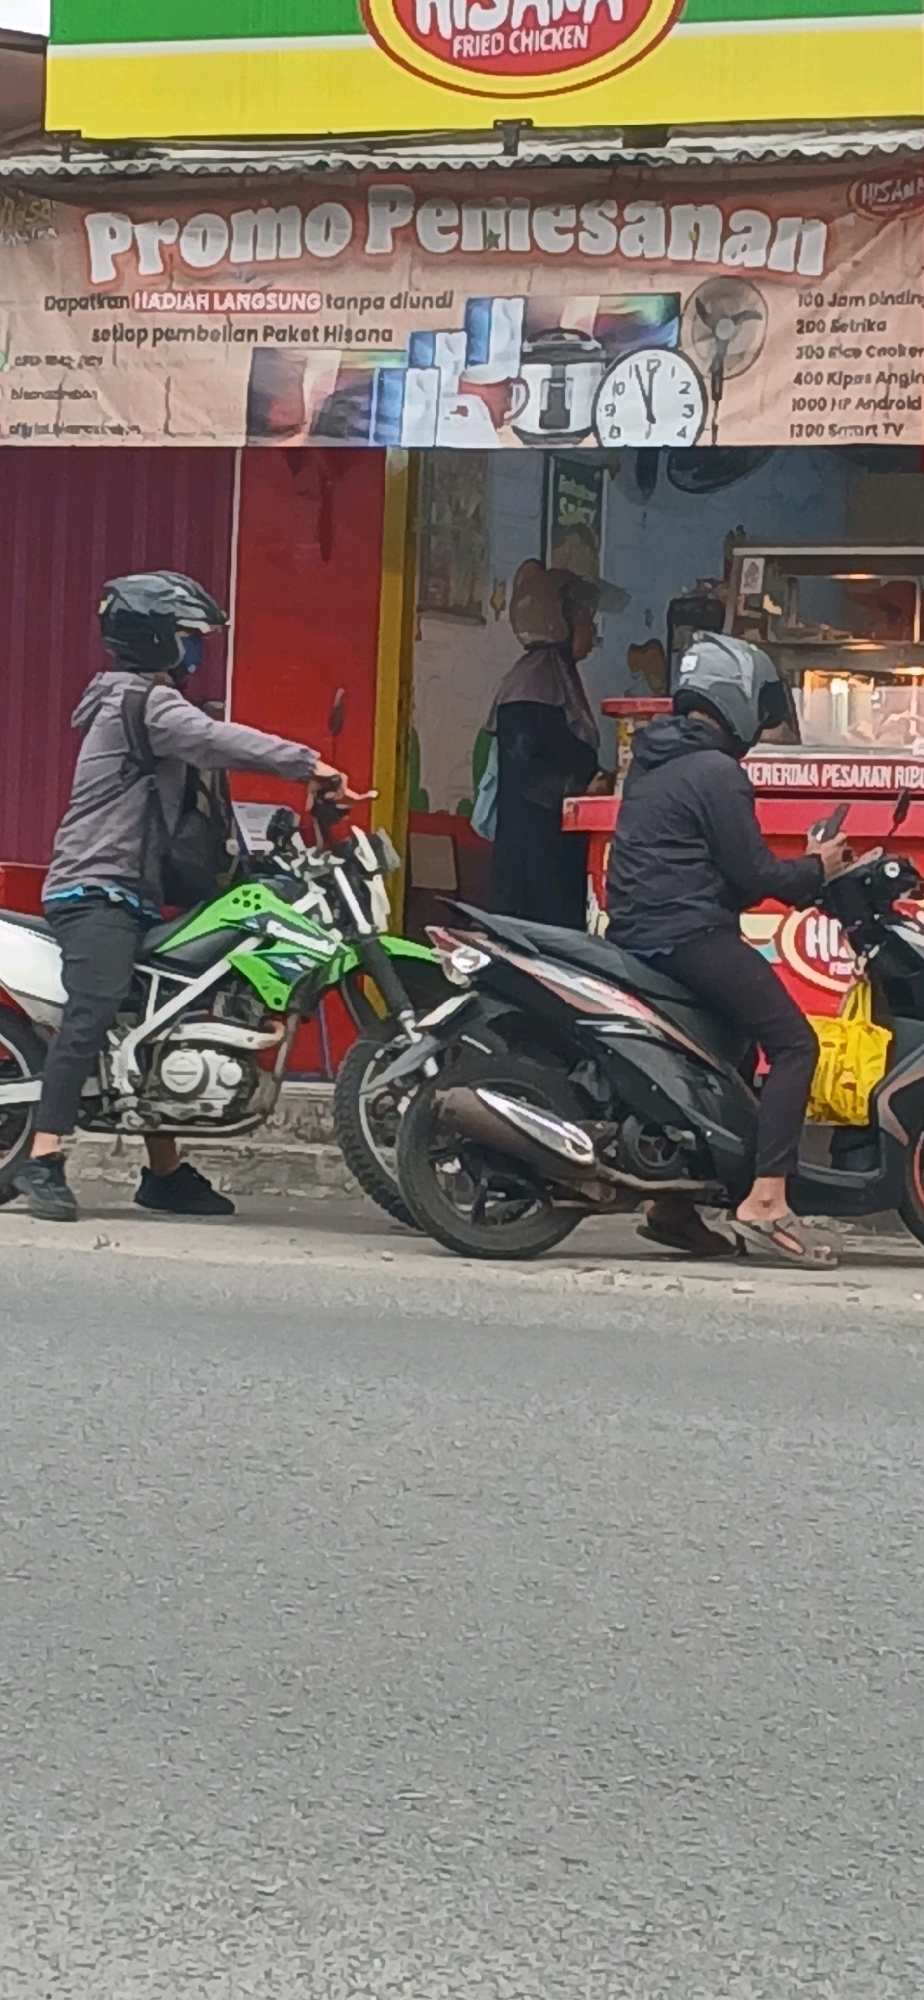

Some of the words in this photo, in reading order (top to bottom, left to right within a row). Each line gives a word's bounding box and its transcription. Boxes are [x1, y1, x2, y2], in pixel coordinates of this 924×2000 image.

[453, 32, 504, 58] FRIED
[509, 25, 588, 55] CHICKEN
[85, 202, 352, 283] Promo
[365, 184, 827, 276] Pemesanan
[44, 293, 130, 317] Dapatkan
[134, 291, 209, 310] HADIAH
[213, 292, 322, 311] LANGSUNG
[326, 294, 385, 315] tanpa
[390, 291, 454, 310] diundi
[798, 292, 824, 308] 100
[828, 292, 866, 307] Jam
[796, 319, 826, 334] 200
[830, 317, 887, 333] Setrika
[92, 323, 149, 348] setiap
[152, 324, 258, 347] pembelian
[263, 325, 319, 343] Paket
[324, 324, 393, 343] Hisana
[793, 371, 824, 385] 400
[612, 380, 625, 397] 10
[679, 381, 692, 394] 2
[604, 402, 616, 417] 9
[682, 404, 695, 419] 3
[792, 397, 827, 412] 1000
[855, 395, 922, 410] Android
[677, 426, 687, 439] 4
[882, 422, 904, 437] TV
